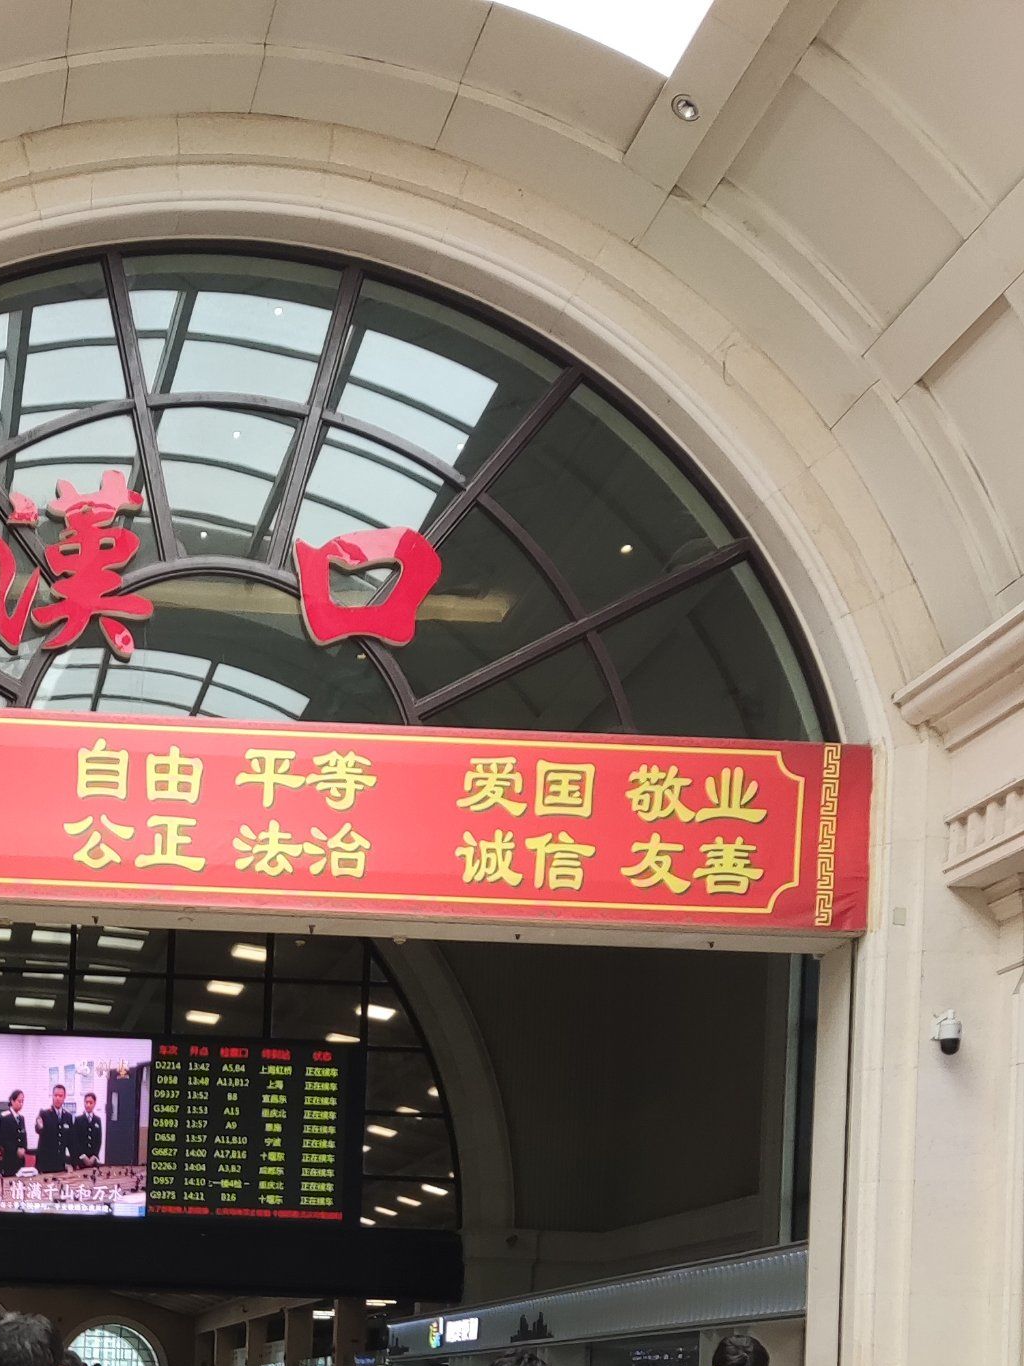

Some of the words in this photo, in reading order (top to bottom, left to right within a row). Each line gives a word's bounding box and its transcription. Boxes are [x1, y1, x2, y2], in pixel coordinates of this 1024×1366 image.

[78, 742, 201, 796] 自由
[236, 750, 376, 810] 平等
[458, 758, 594, 818] 爱国
[628, 767, 765, 825] 敬业
[66, 816, 205, 871] 公正
[236, 823, 370, 877] 法治
[456, 830, 595, 889] 诚信
[622, 834, 761, 893] 友善
[188, 1091, 208, 1099] 13:52
[188, 1106, 207, 1114] 13:53
[187, 1120, 207, 1128] 13:57
[186, 1149, 206, 1157] 14:00
[185, 1163, 205, 1171] 14:04
[10, 1181, 125, 1201] 情满千山和万水
[184, 1192, 204, 1200] 14:11
